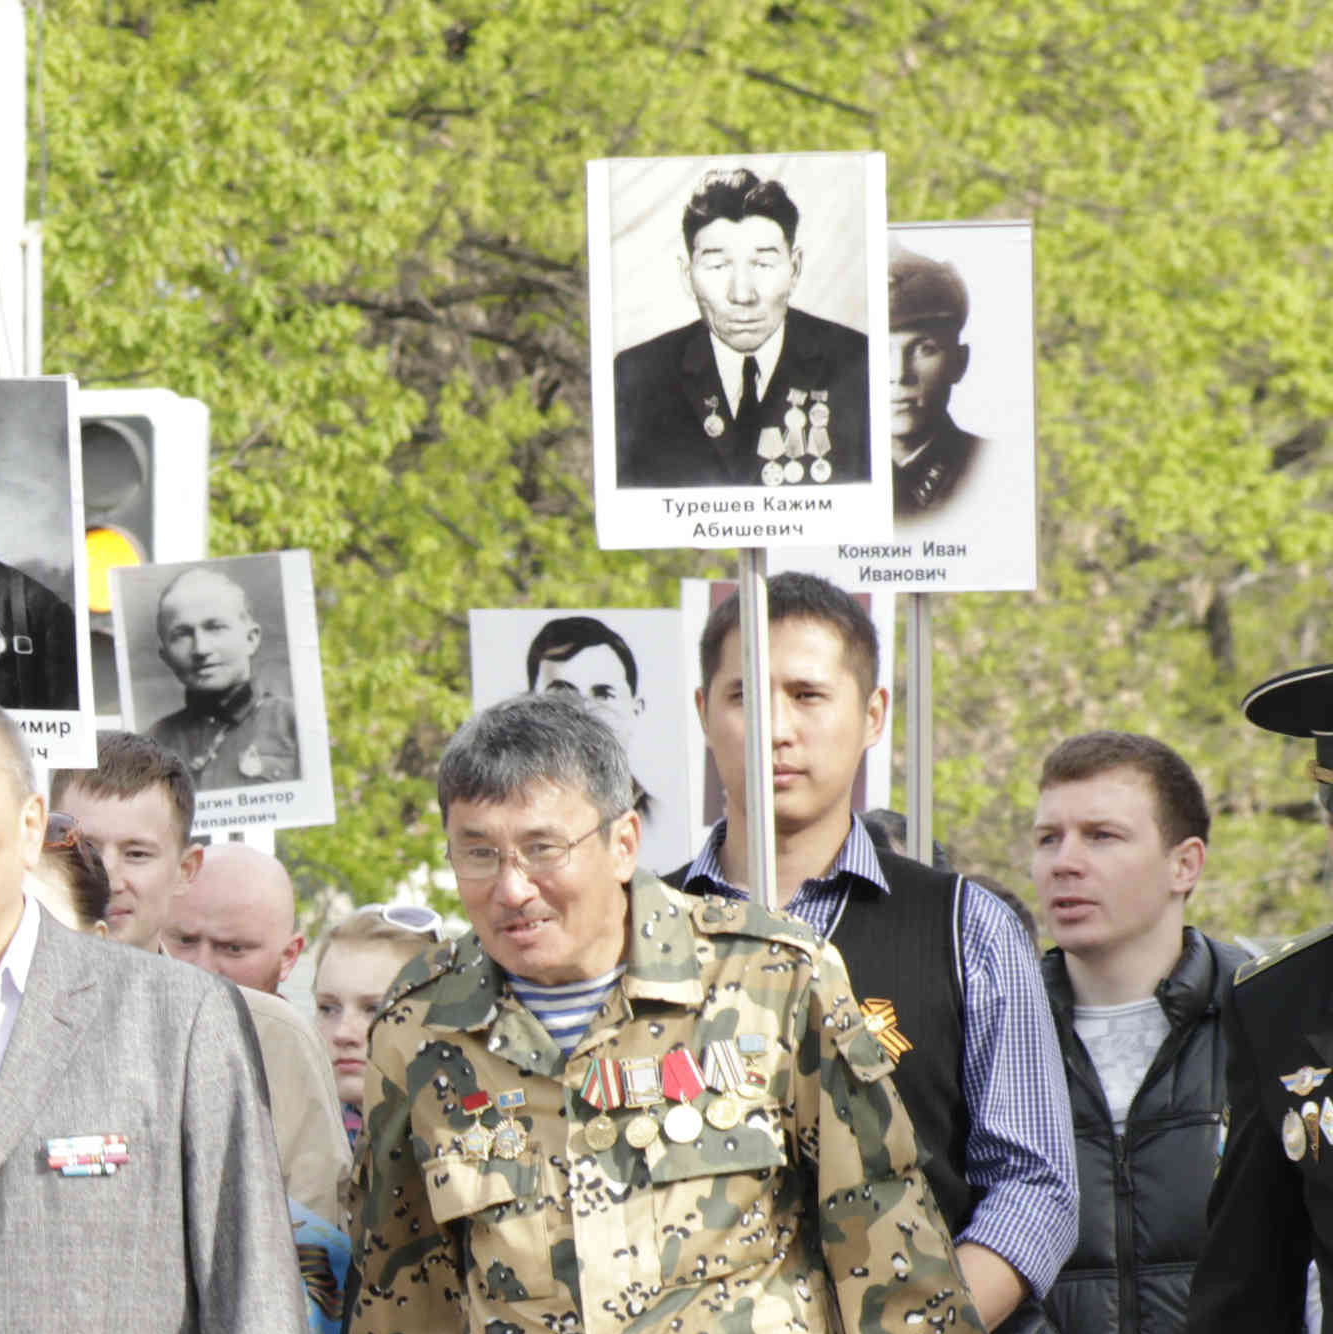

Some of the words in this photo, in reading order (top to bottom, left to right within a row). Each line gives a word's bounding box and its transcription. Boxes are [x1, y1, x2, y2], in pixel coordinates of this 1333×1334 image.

[662, 498, 755, 517] Турешев
[764, 497, 833, 512] Кажим
[693, 522, 804, 538] Абишевич
[838, 544, 912, 559] Коняхин
[923, 540, 967, 557] Иван
[859, 566, 947, 582] Иванович
[237, 791, 295, 806] Виктор
